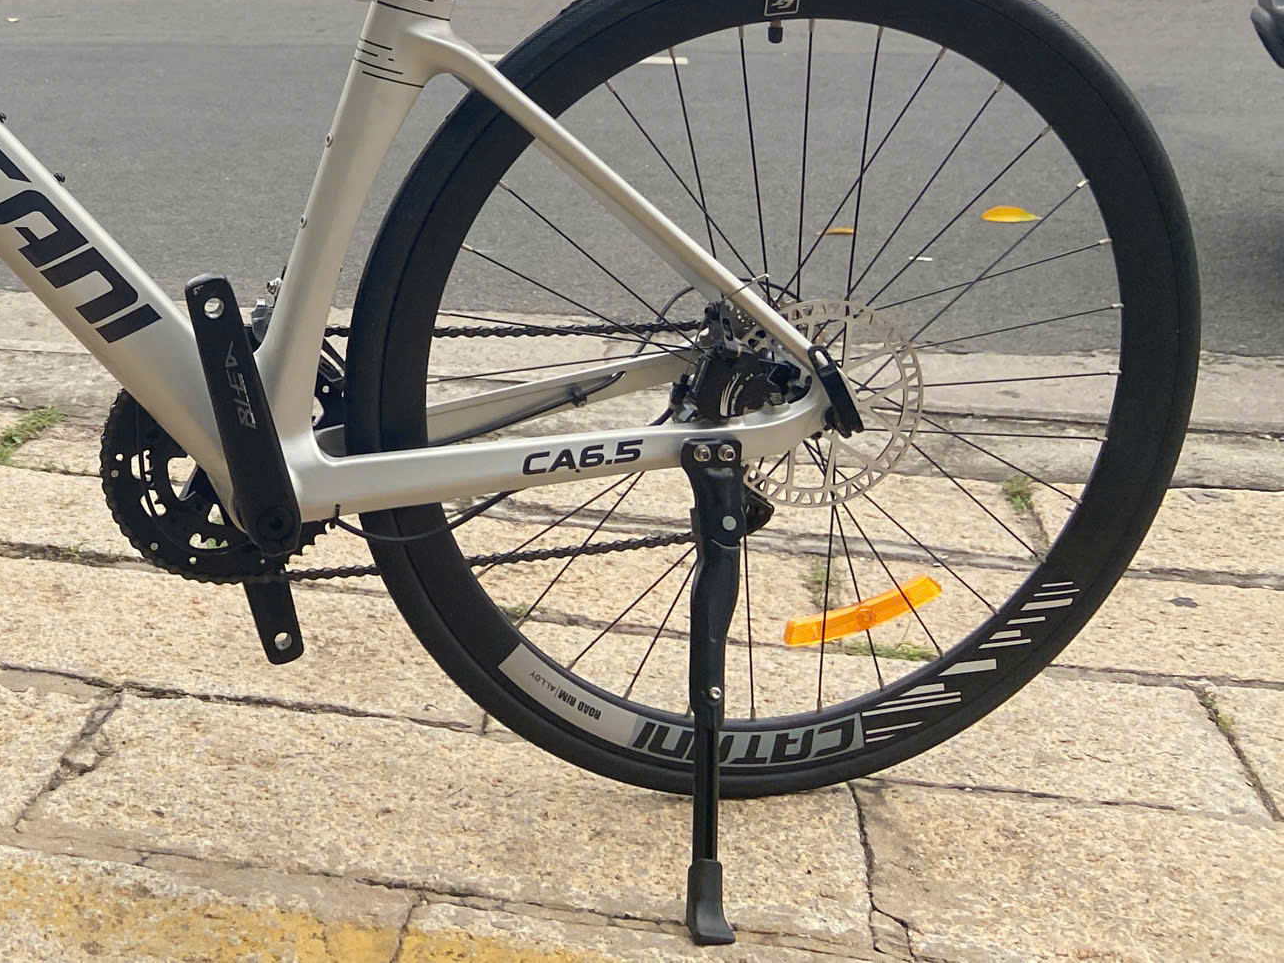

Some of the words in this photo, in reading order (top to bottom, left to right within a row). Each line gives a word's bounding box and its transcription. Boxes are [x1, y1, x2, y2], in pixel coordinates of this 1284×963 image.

[522, 439, 645, 476] CA6.5
[529, 671, 556, 692] ALLOY
[577, 701, 602, 720] ROAD
[631, 718, 855, 766] CATNI
